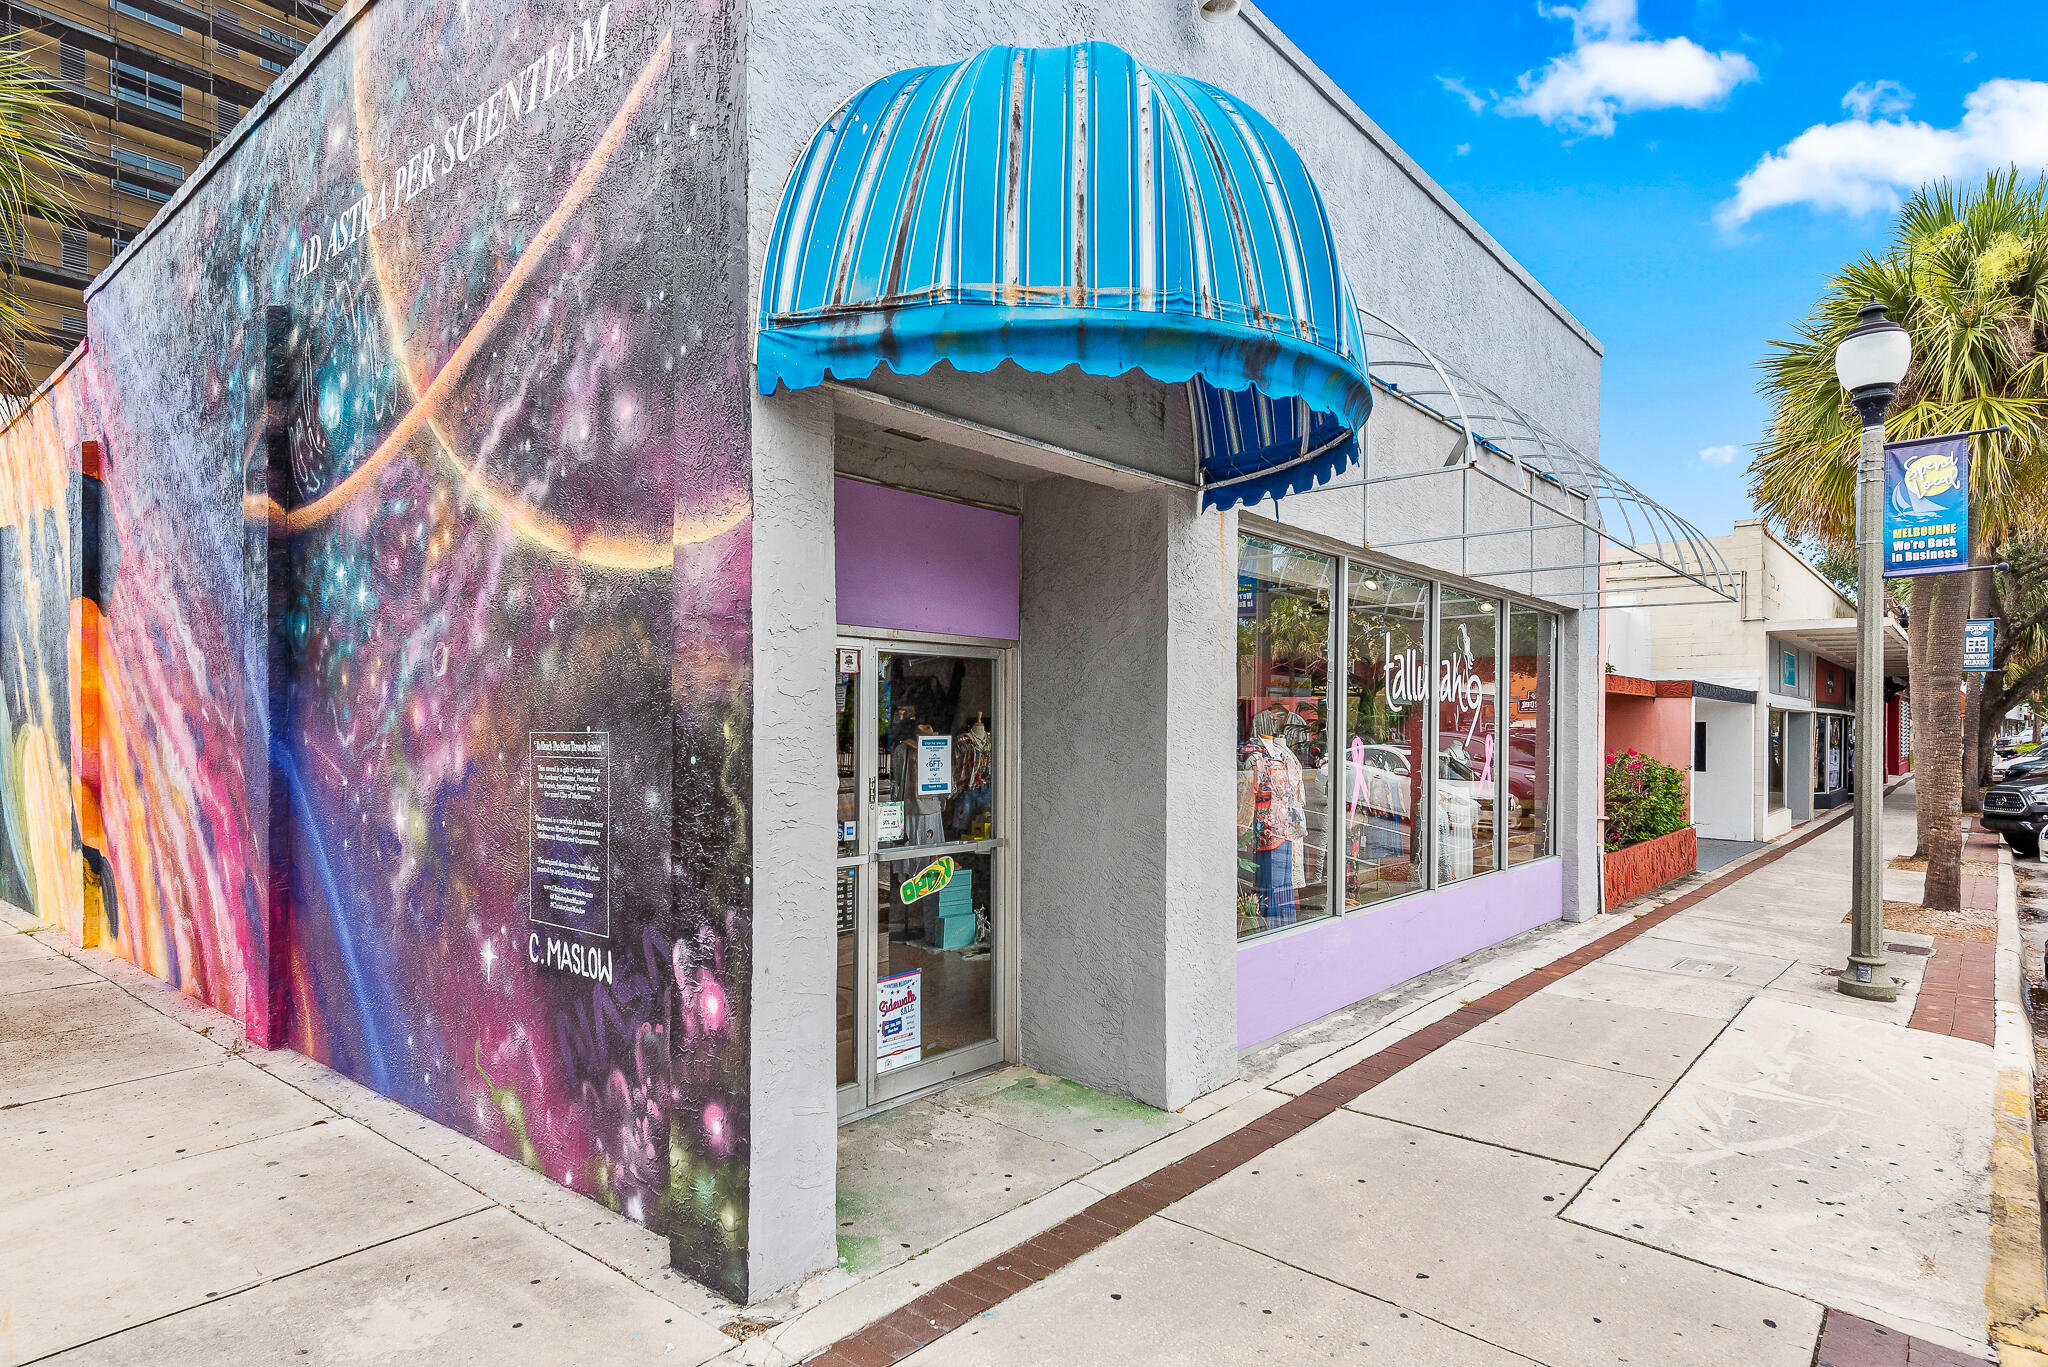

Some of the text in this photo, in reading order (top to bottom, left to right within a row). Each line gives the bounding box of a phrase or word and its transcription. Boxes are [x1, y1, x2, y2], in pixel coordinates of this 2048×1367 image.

[295, 3, 610, 282] AD ASTRA PER SCIENTIAM
[1903, 451, 1959, 482] Spend
[1910, 466, 1961, 499] Local
[1893, 523, 1957, 539] MELBOURNE
[1893, 536, 1957, 551] We're Back
[1892, 549, 1958, 563] In Business
[929, 760, 941, 768] 6FT
[902, 857, 952, 901] OPEN
[547, 937, 613, 985] MASLOW
[879, 990, 917, 1017] Sidewalk
[900, 1003, 915, 1016] SALE
